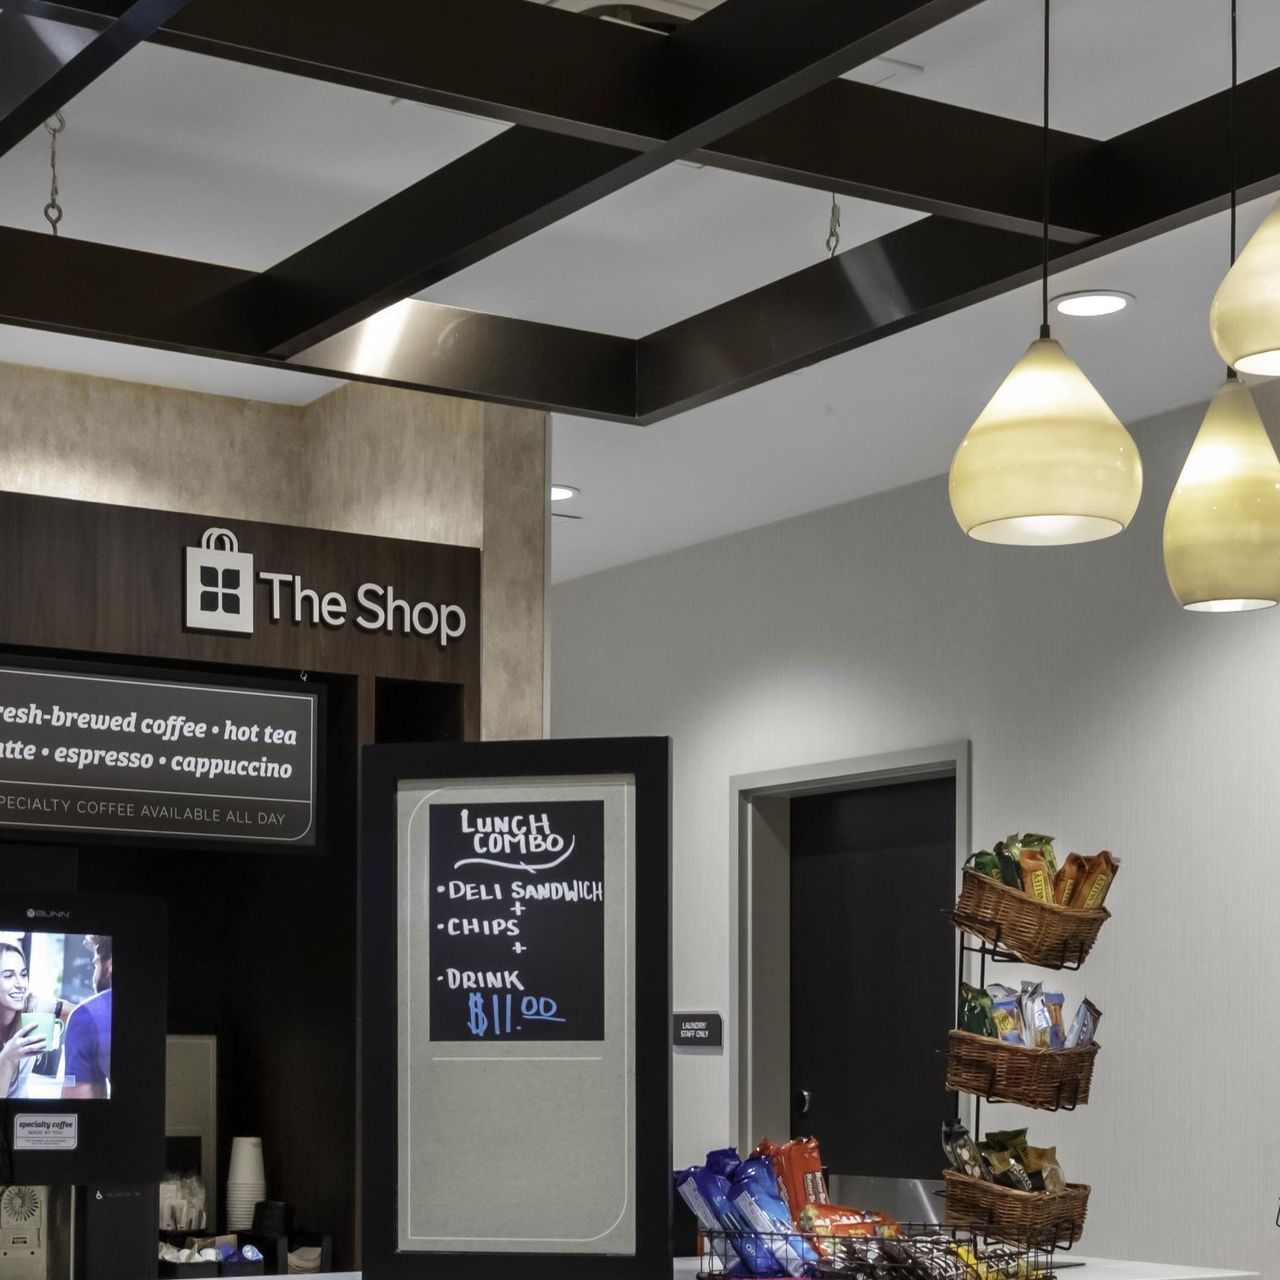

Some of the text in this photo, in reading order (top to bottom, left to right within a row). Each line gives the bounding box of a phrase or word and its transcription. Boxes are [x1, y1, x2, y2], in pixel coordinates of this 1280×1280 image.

[259, 572, 467, 646] The Shop
[141, 716, 207, 741] coffee
[224, 720, 259, 742] hot
[264, 726, 297, 745] tea
[54, 746, 153, 769] espresso
[171, 755, 292, 778] cappuccino
[77, 801, 135, 816] COFFEE
[141, 805, 220, 821] AVAILABLE
[226, 810, 252, 823] ALL
[258, 812, 285, 825] DAY
[461, 809, 550, 835] LUNCH
[473, 833, 564, 853] COMBO
[449, 880, 603, 902] DELI SANDWICH
[447, 919, 520, 935] CHIPS
[447, 968, 524, 990] DRINK
[680, 1030, 709, 1038] STAFF ONLY
[52, 1121, 73, 1129] coffee
